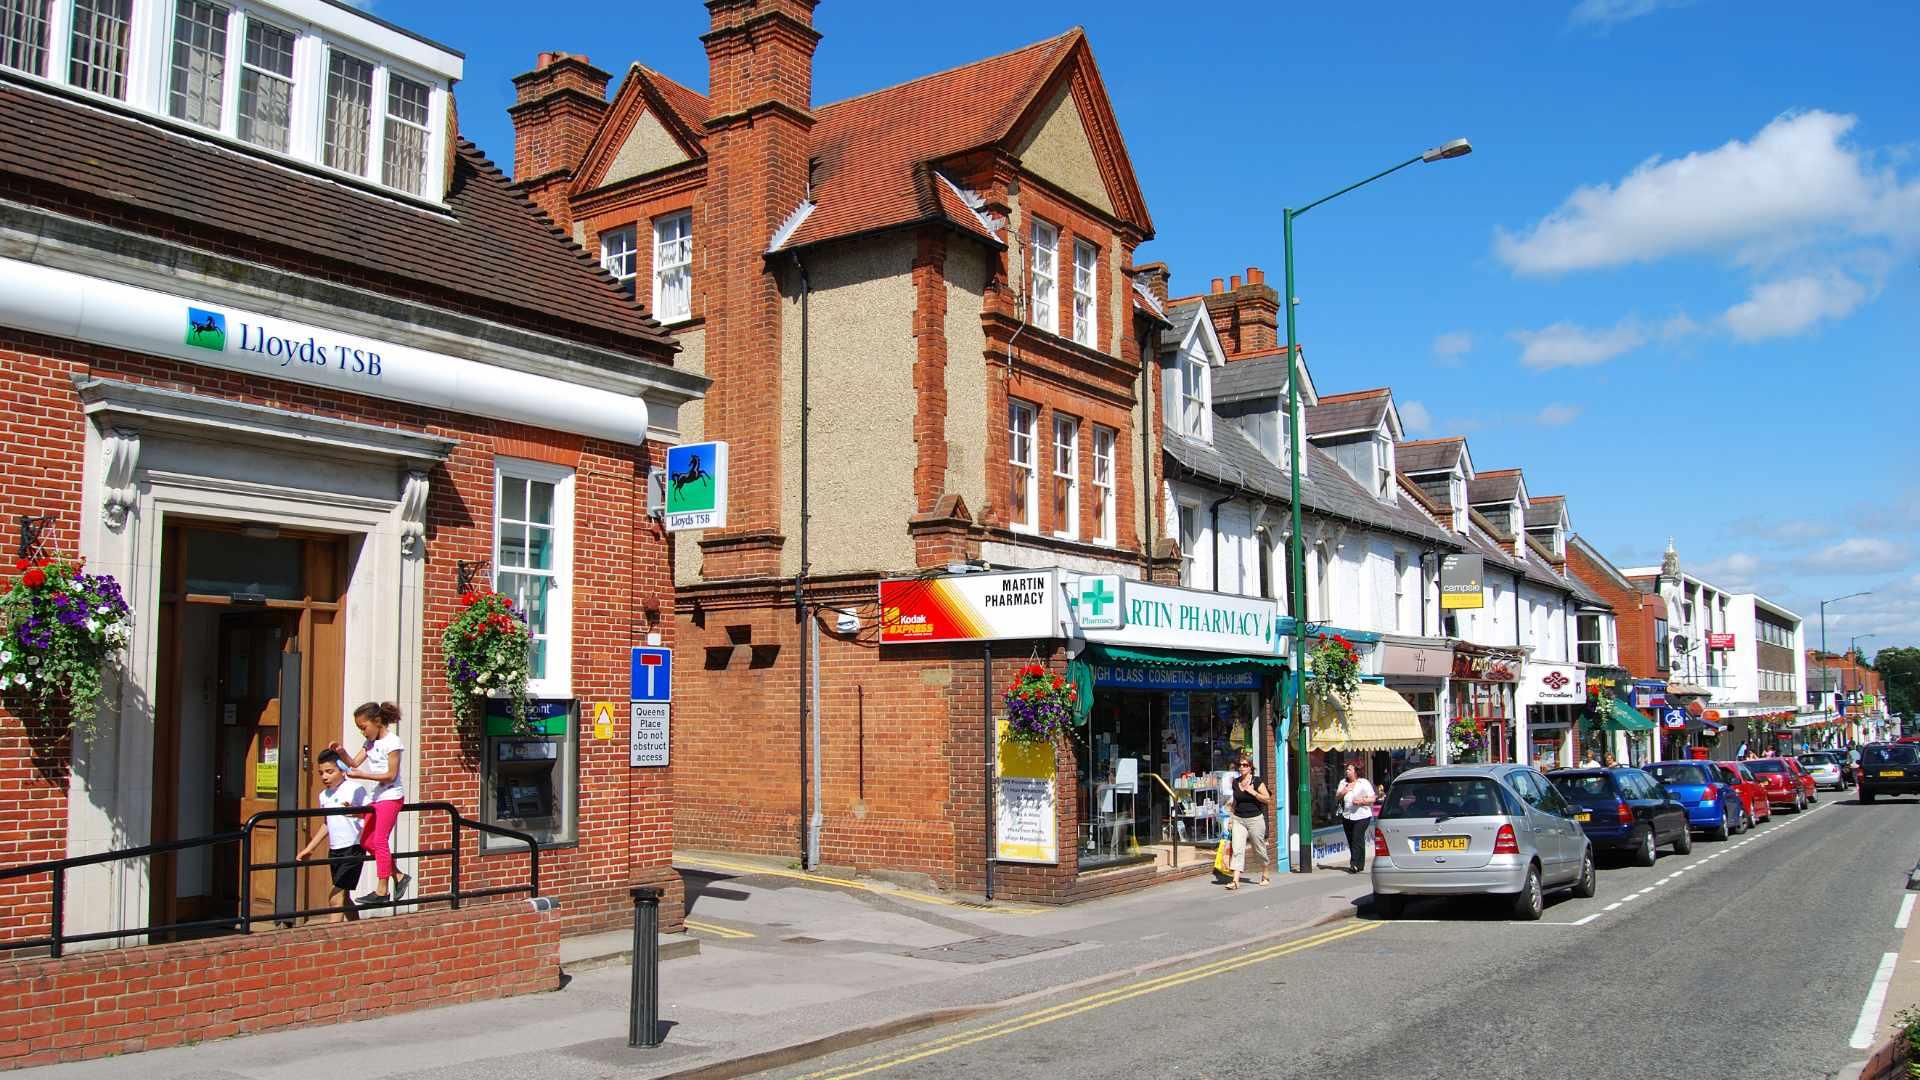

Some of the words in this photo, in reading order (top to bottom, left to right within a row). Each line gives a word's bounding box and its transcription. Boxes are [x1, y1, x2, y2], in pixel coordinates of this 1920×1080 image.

[239, 322, 327, 367] Lloyds
[335, 345, 382, 376] TSB
[671, 514, 694, 527] Lloyds
[696, 514, 710, 524] TSB
[1002, 577, 1045, 591] MARTIN
[985, 592, 1044, 607] PHARMACY
[900, 614, 926, 625] Kodak
[1082, 616, 1114, 625] Pharmacy
[1179, 604, 1262, 637] PHARMACY
[889, 624, 934, 634] EXPRESS
[1115, 667, 1144, 682] CLASS
[1149, 669, 1195, 685] COSMETICS
[1199, 671, 1213, 686] AND
[1217, 672, 1254, 685] PERFUMES
[1538, 691, 1573, 700] Chancellors
[636, 708, 665, 716] Queens
[640, 720, 661, 728] Place
[637, 731, 649, 739] Do
[650, 731, 663, 739] not
[633, 742, 666, 751] obstruct
[1420, 838, 1446, 849] BG03
[1448, 838, 1465, 849] YLH
